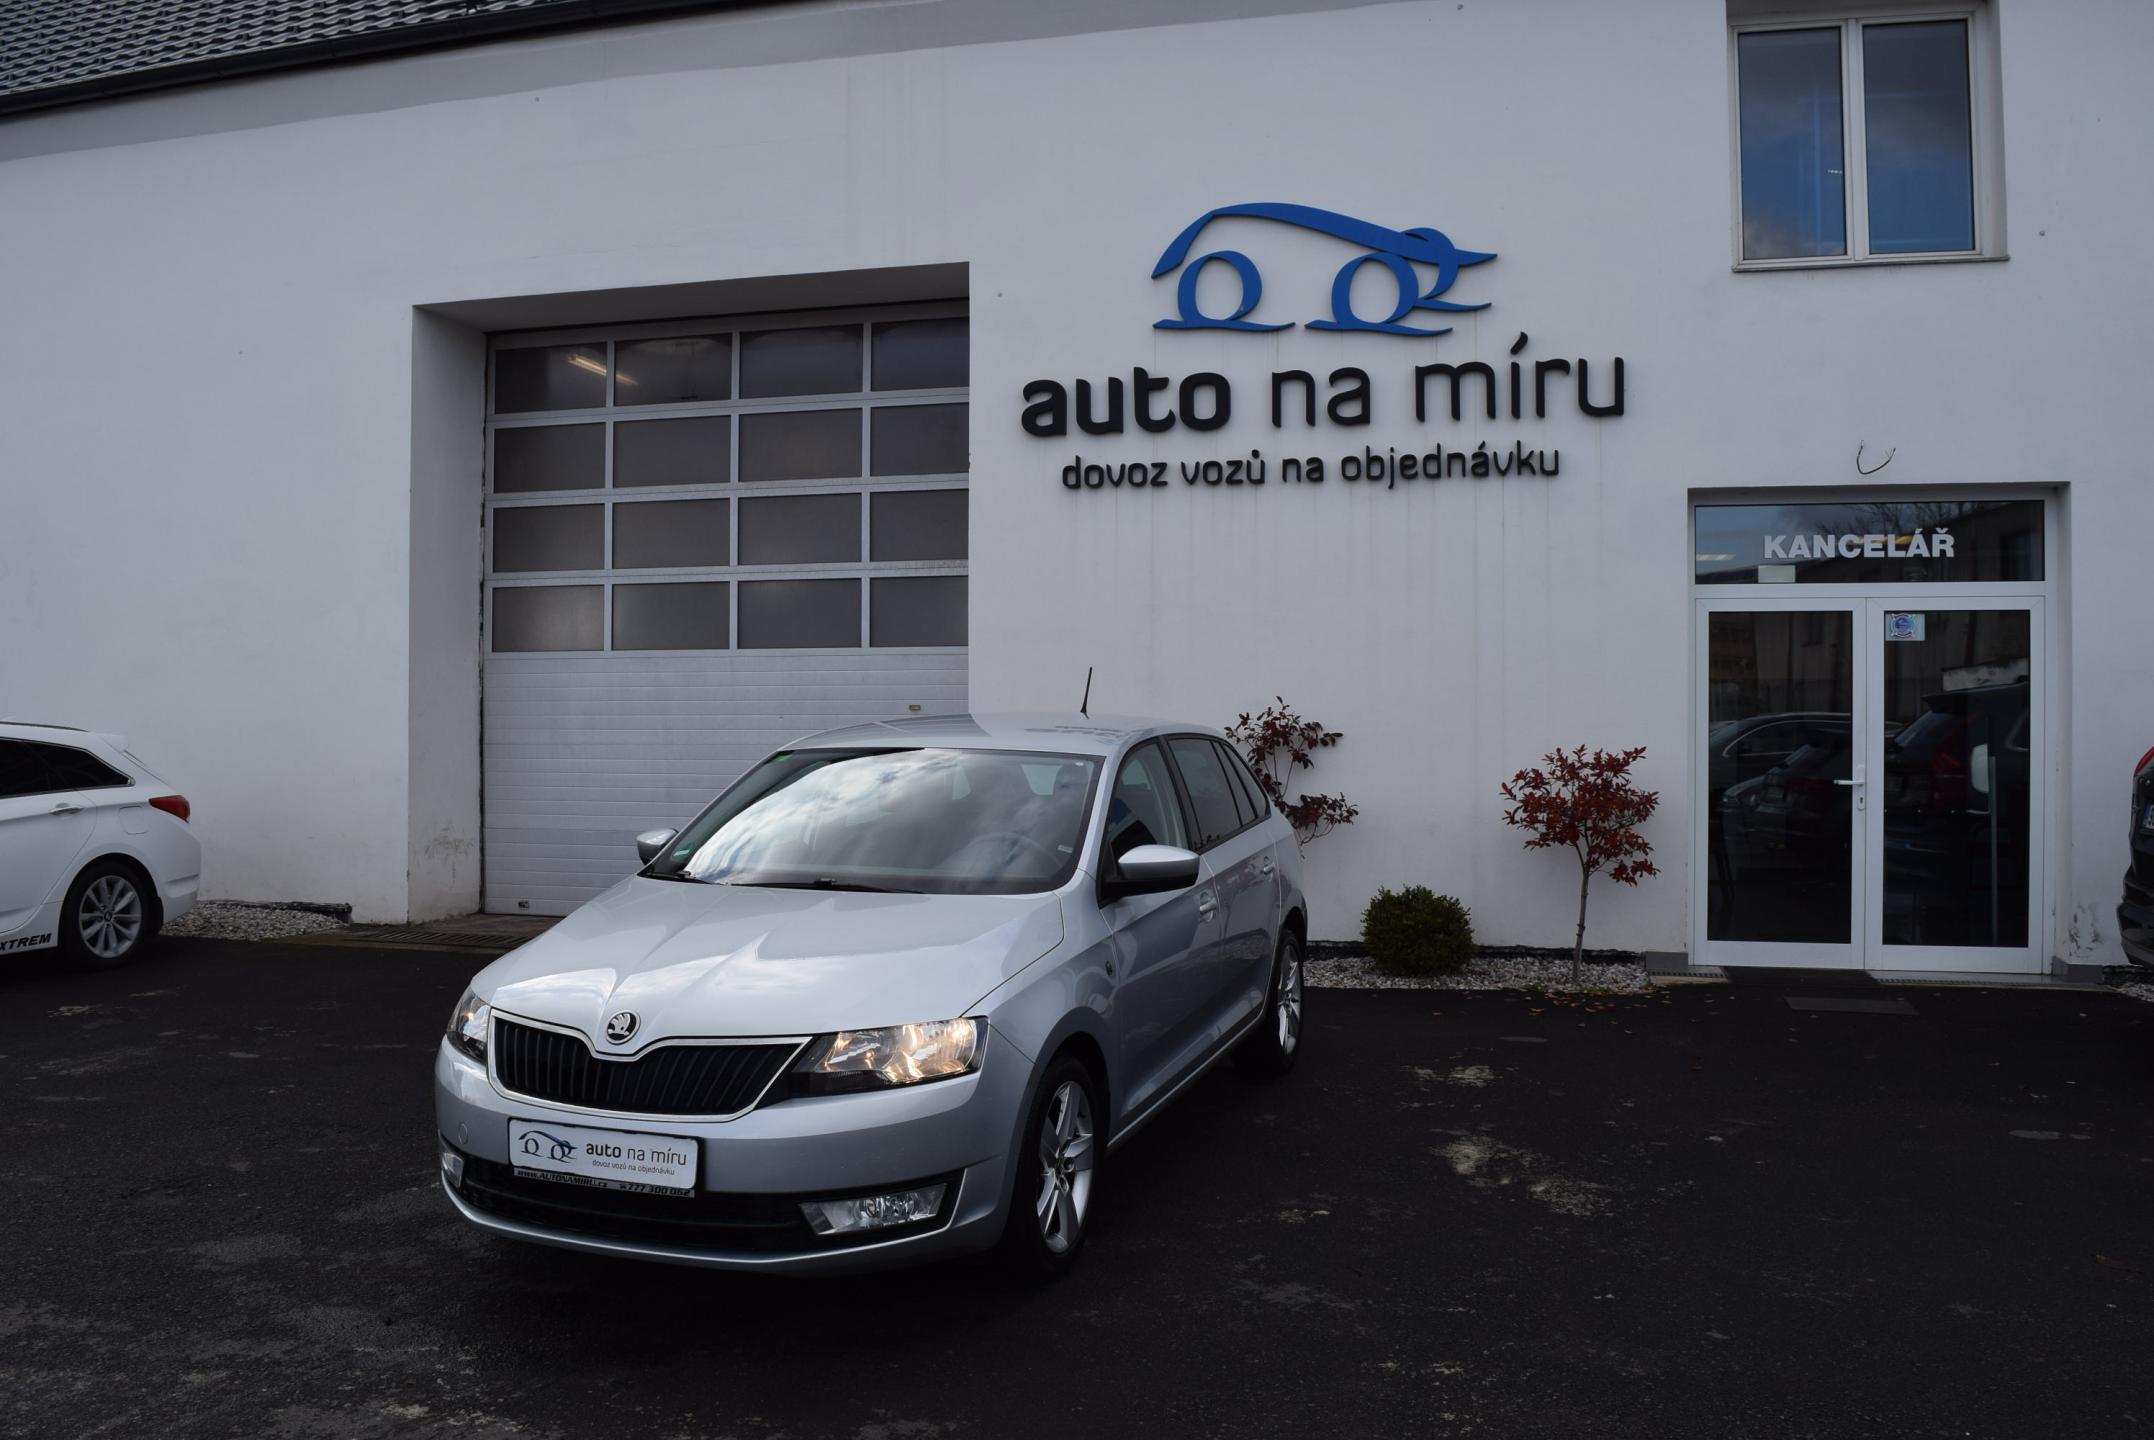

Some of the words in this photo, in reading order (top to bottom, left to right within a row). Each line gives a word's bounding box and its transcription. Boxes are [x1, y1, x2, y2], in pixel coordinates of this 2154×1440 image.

[1021, 366, 1232, 437] auto
[1271, 365, 1371, 428] na
[1415, 331, 1625, 422] míru
[1062, 455, 1168, 490] dovoz
[1181, 448, 1266, 485] vozů
[1282, 455, 1325, 483] na
[1341, 440, 1560, 489] objednávku
[1764, 527, 1955, 559] KANCELÁŘ
[586, 1143, 622, 1159] auto
[627, 1148, 645, 1161] na
[651, 1147, 687, 1166] míru
[592, 1159, 611, 1168] dovoz
[611, 1162, 627, 1170] vozů
[628, 1164, 637, 1172] na
[637, 1164, 675, 1176] objednávku
